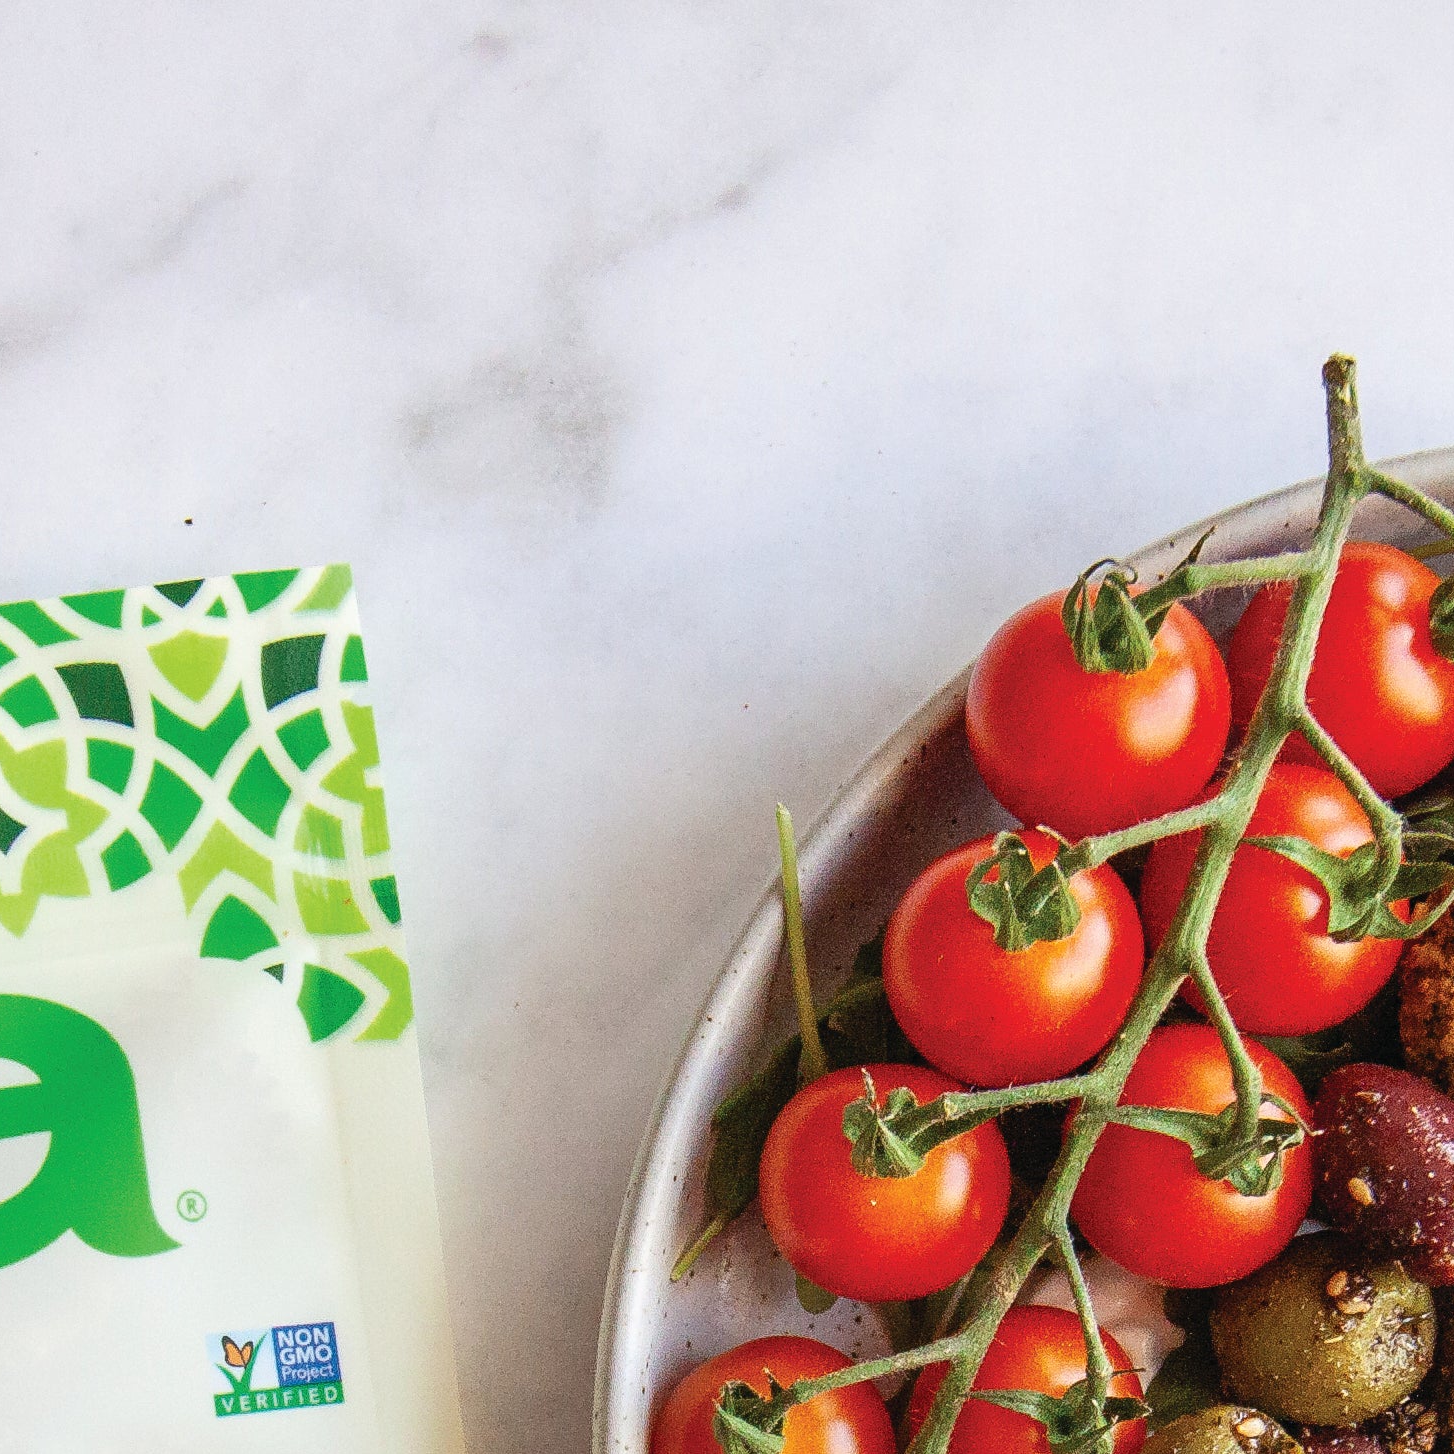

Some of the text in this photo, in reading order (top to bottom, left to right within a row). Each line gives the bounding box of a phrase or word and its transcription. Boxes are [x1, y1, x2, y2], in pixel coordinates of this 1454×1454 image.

[277, 1327, 331, 1348] NON
[279, 1344, 333, 1366] GMO
[281, 1364, 335, 1382] Project
[221, 1386, 338, 1413] VERIFIED
